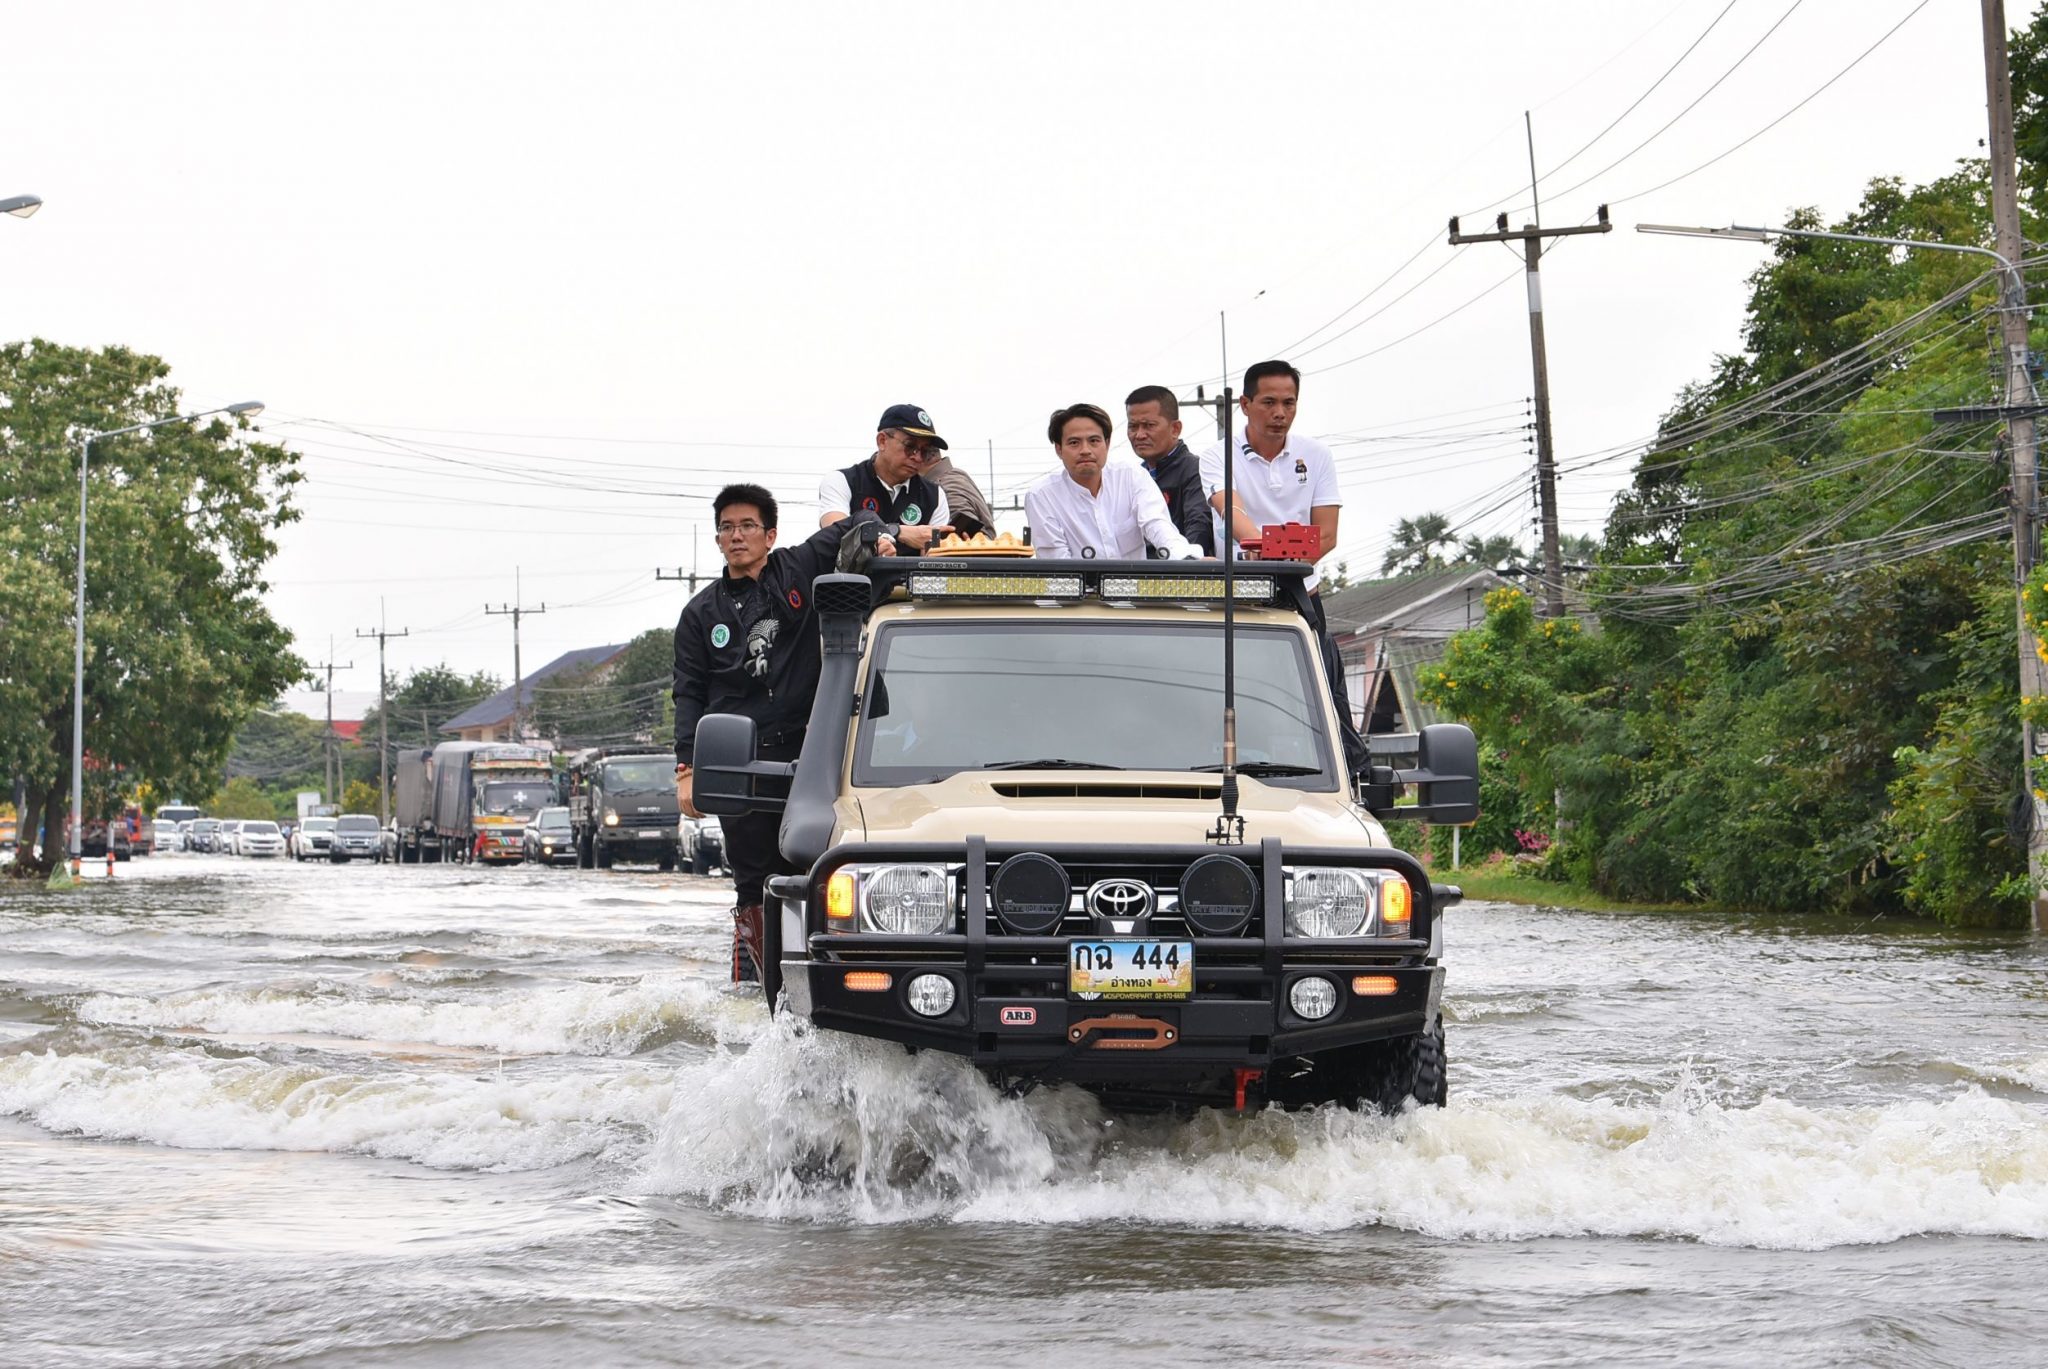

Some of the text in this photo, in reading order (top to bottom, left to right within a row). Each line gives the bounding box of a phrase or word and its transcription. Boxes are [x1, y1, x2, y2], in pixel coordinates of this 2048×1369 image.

[1075, 944, 1179, 970] กฉ 444
[1111, 976, 1152, 988] อ่างทอง
[1005, 1011, 1033, 1021] ARB
